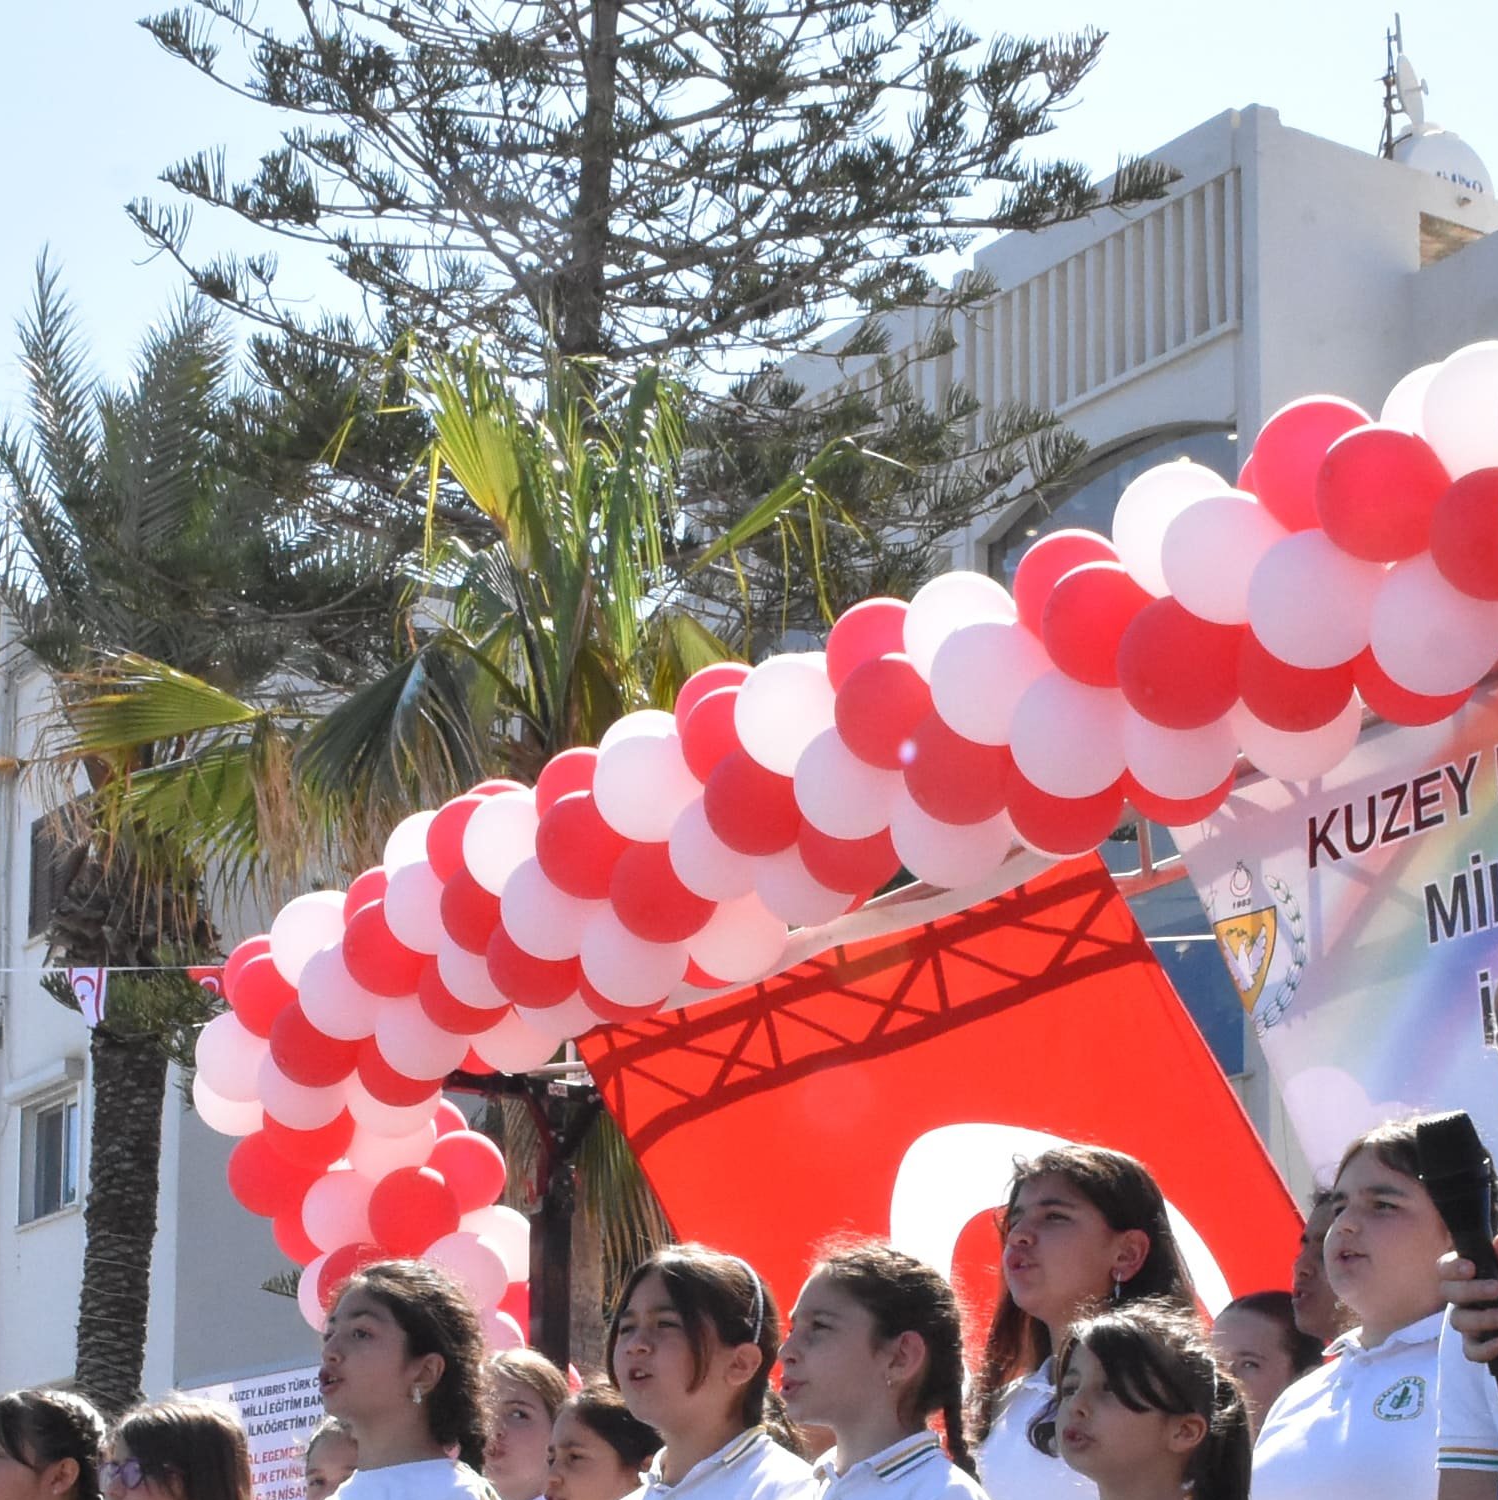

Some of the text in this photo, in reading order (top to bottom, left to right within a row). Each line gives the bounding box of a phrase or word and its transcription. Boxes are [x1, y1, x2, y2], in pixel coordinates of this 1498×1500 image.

[1307, 755, 1480, 869] KUZEY
[228, 1387, 256, 1403] KUZEY
[258, 1382, 286, 1397] KIBRIS
[288, 1376, 312, 1391] TÜRK
[242, 1401, 268, 1418] MİLLİ
[269, 1396, 302, 1414] EĞİTİM
[248, 1415, 307, 1437] İLKÖĞRETİM
